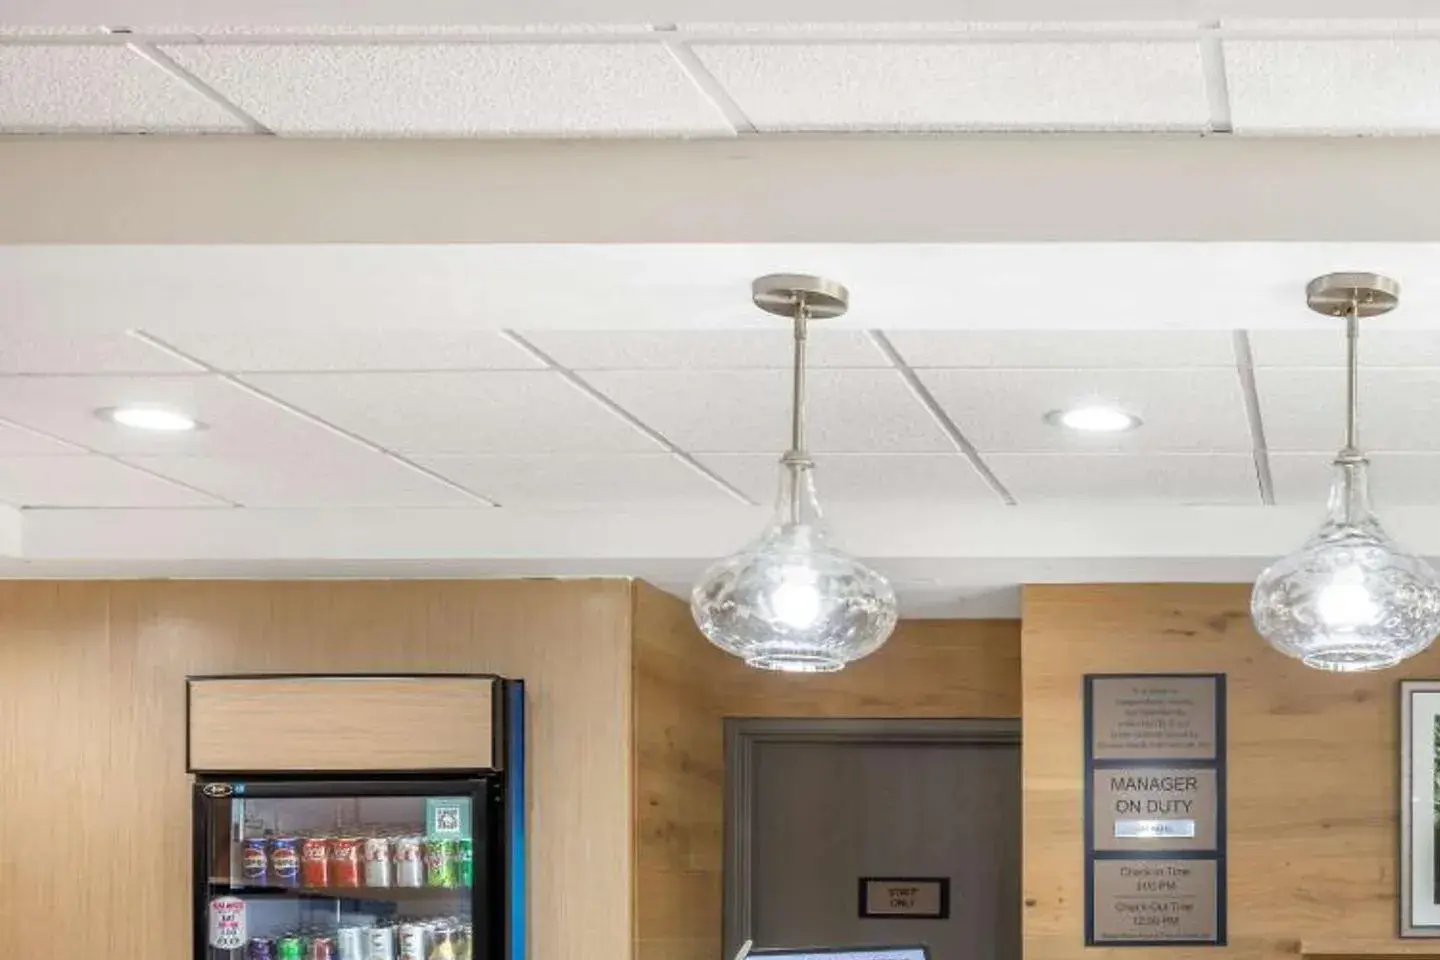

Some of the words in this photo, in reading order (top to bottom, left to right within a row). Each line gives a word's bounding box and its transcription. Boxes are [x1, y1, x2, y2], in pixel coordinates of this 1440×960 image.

[1111, 777, 1198, 792] MANAGER
[1116, 799, 1141, 814] ON
[1147, 799, 1193, 814] DUTY
